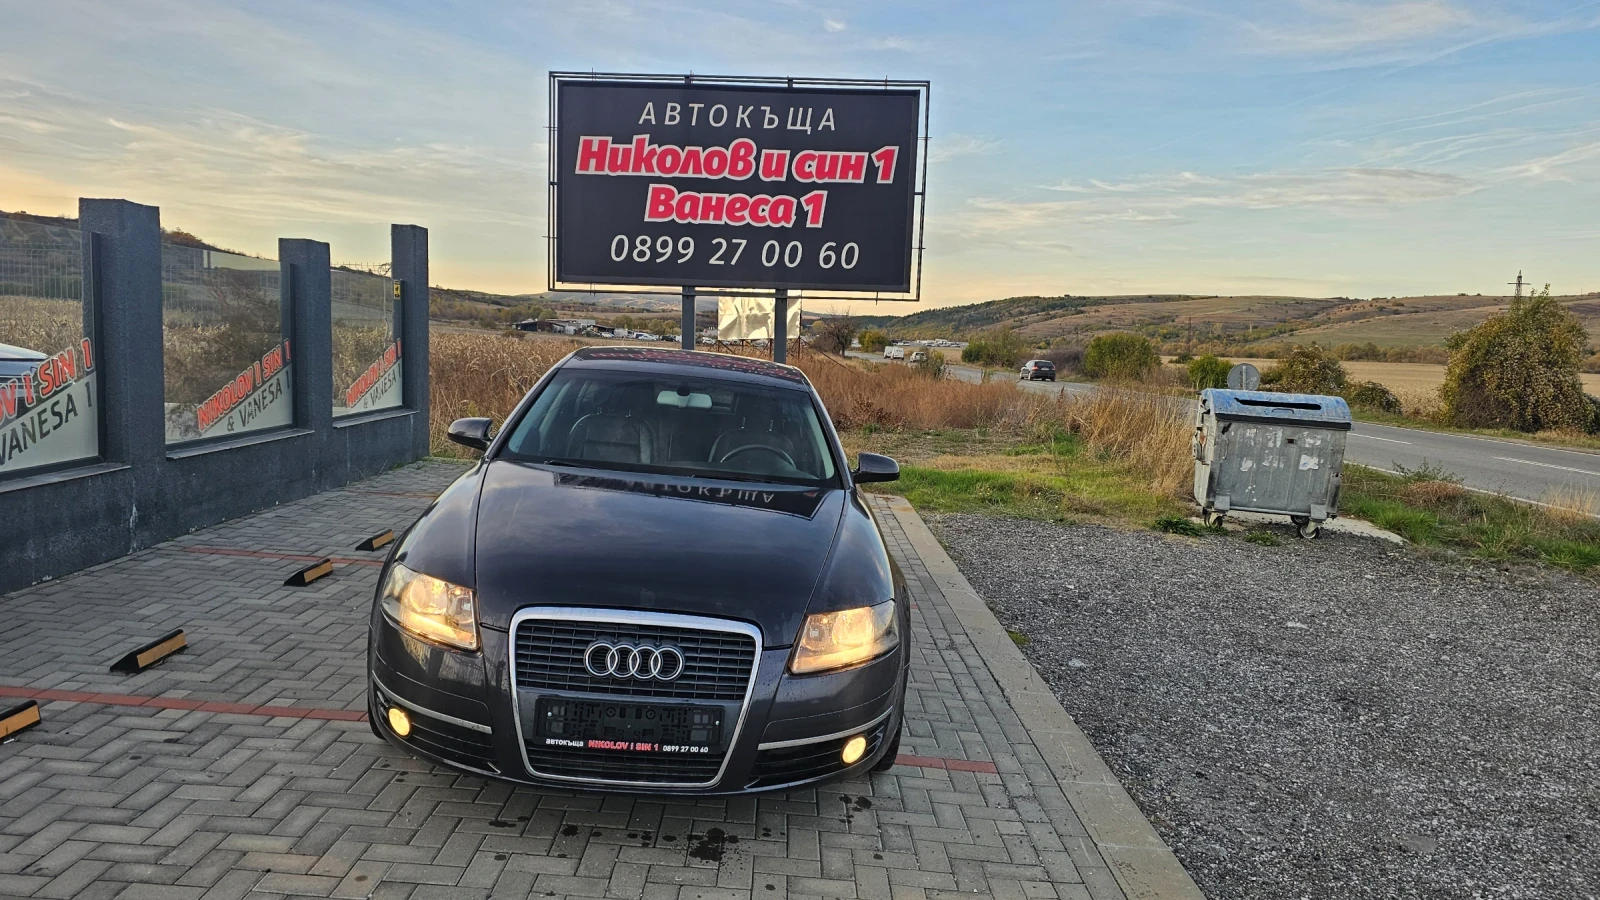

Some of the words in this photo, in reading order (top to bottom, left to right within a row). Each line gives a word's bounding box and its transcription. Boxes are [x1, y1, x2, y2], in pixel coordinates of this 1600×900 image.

[639, 101, 836, 135] АВТОКЪЩА
[575, 134, 757, 180] Николов
[759, 149, 791, 182] и
[792, 150, 869, 184] син
[871, 146, 899, 184] 1
[644, 183, 797, 227] Ванеса
[801, 190, 828, 228] 1
[610, 234, 695, 264] 0899
[709, 238, 748, 266] 27
[761, 240, 803, 268] 00
[818, 242, 860, 269] 60
[38, 346, 77, 398] SIN
[81, 337, 94, 371] 1
[197, 366, 254, 432] NIKOLOV
[262, 344, 283, 380] SIN
[284, 338, 291, 362] 1
[370, 369, 397, 406] VANESA
[226, 415, 235, 431] &
[239, 377, 283, 427] VANESA
[545, 738, 584, 747] автокъща
[588, 740, 629, 750] NIKOLOV
[635, 742, 652, 752] SIN
[653, 743, 659, 752] 1
[680, 745, 690, 753] 27
